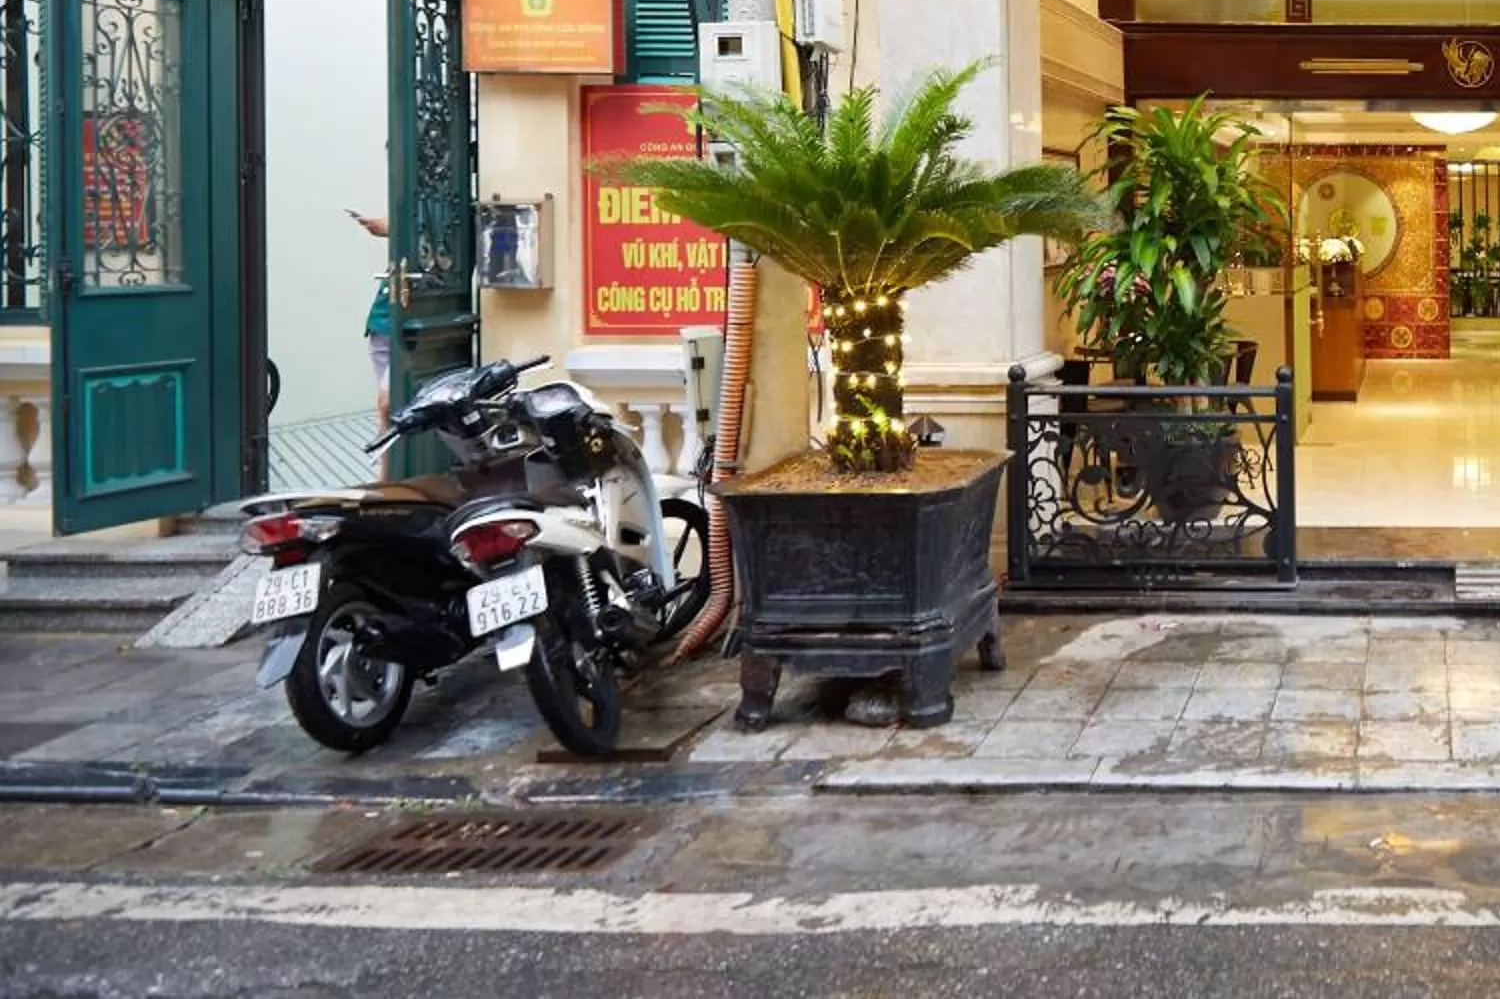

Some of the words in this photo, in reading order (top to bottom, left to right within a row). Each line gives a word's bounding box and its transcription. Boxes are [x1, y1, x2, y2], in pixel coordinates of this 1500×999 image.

[622, 237, 645, 268] VŨ
[685, 237, 719, 274] VẬT
[597, 280, 645, 312] CÔNG
[649, 285, 673, 319] CỤ
[675, 277, 701, 312] HỖ
[703, 286, 725, 312] TR
